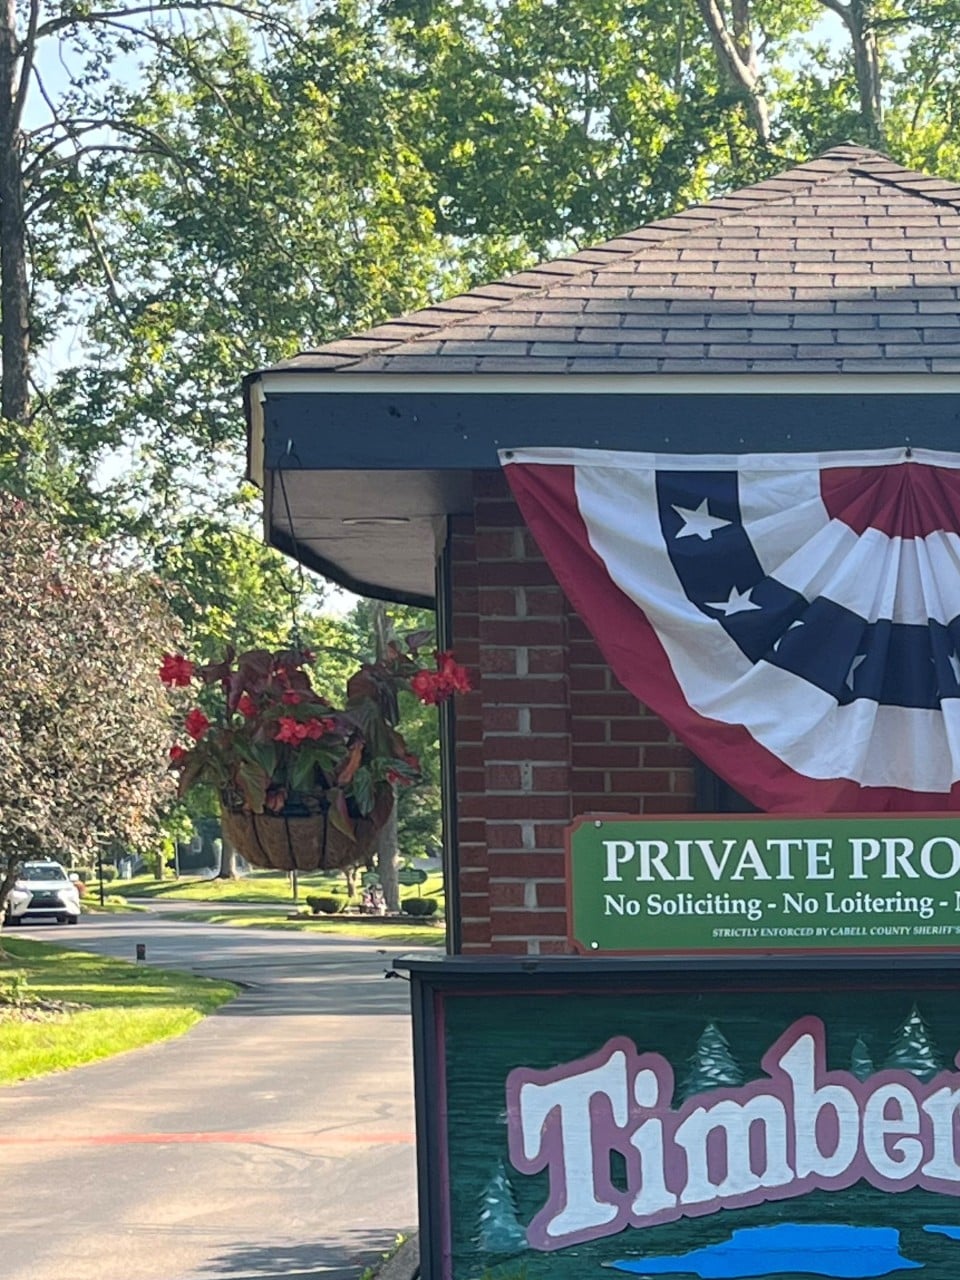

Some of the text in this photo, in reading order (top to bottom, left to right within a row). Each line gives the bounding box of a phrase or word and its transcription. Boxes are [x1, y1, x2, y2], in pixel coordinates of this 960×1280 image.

[602, 838, 835, 882] PRIVATE
[603, 894, 641, 916] No
[647, 892, 762, 921] Soliciting
[782, 892, 819, 914] No
[825, 890, 934, 919] Loitering
[712, 927, 759, 937] STRICTLY
[760, 927, 814, 937] ENFORCED
[815, 927, 829, 936] BY
[830, 926, 868, 936] CABELL
[870, 926, 911, 936] COUNTY
[912, 925, 960, 935] SHERIFF'S
